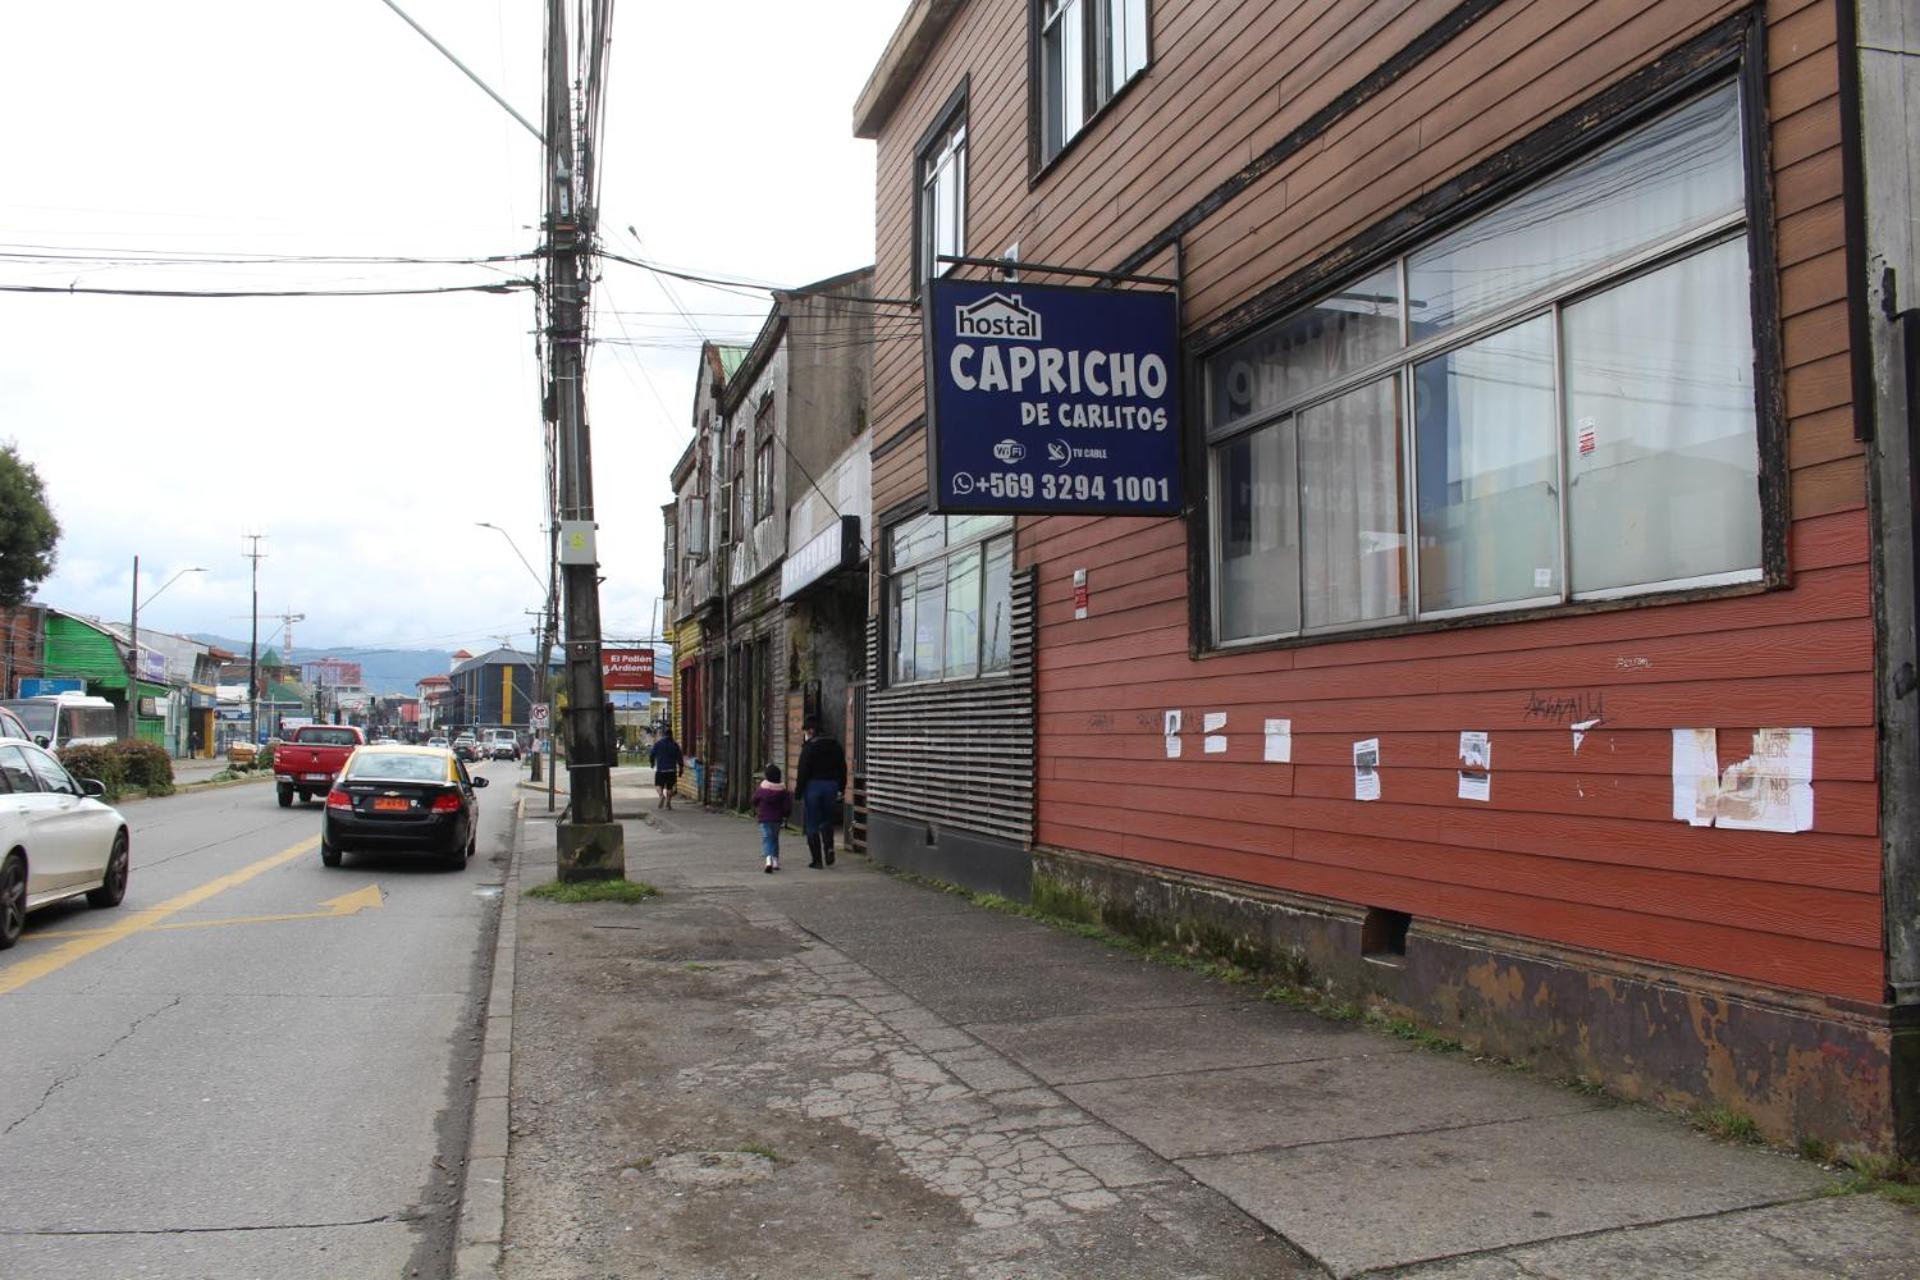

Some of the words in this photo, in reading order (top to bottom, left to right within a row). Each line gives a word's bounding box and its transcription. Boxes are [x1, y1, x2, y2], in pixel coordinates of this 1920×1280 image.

[959, 310, 1037, 337] hostal
[950, 343, 1168, 399] CAPRICHO
[1021, 402, 1050, 426] DE
[1059, 404, 1168, 431] CARLITOS
[976, 473, 1034, 499] +569
[1042, 475, 1105, 501] 3294
[1113, 477, 1169, 502] 1001
[611, 655, 620, 663] El
[611, 664, 653, 672] Ardiente
